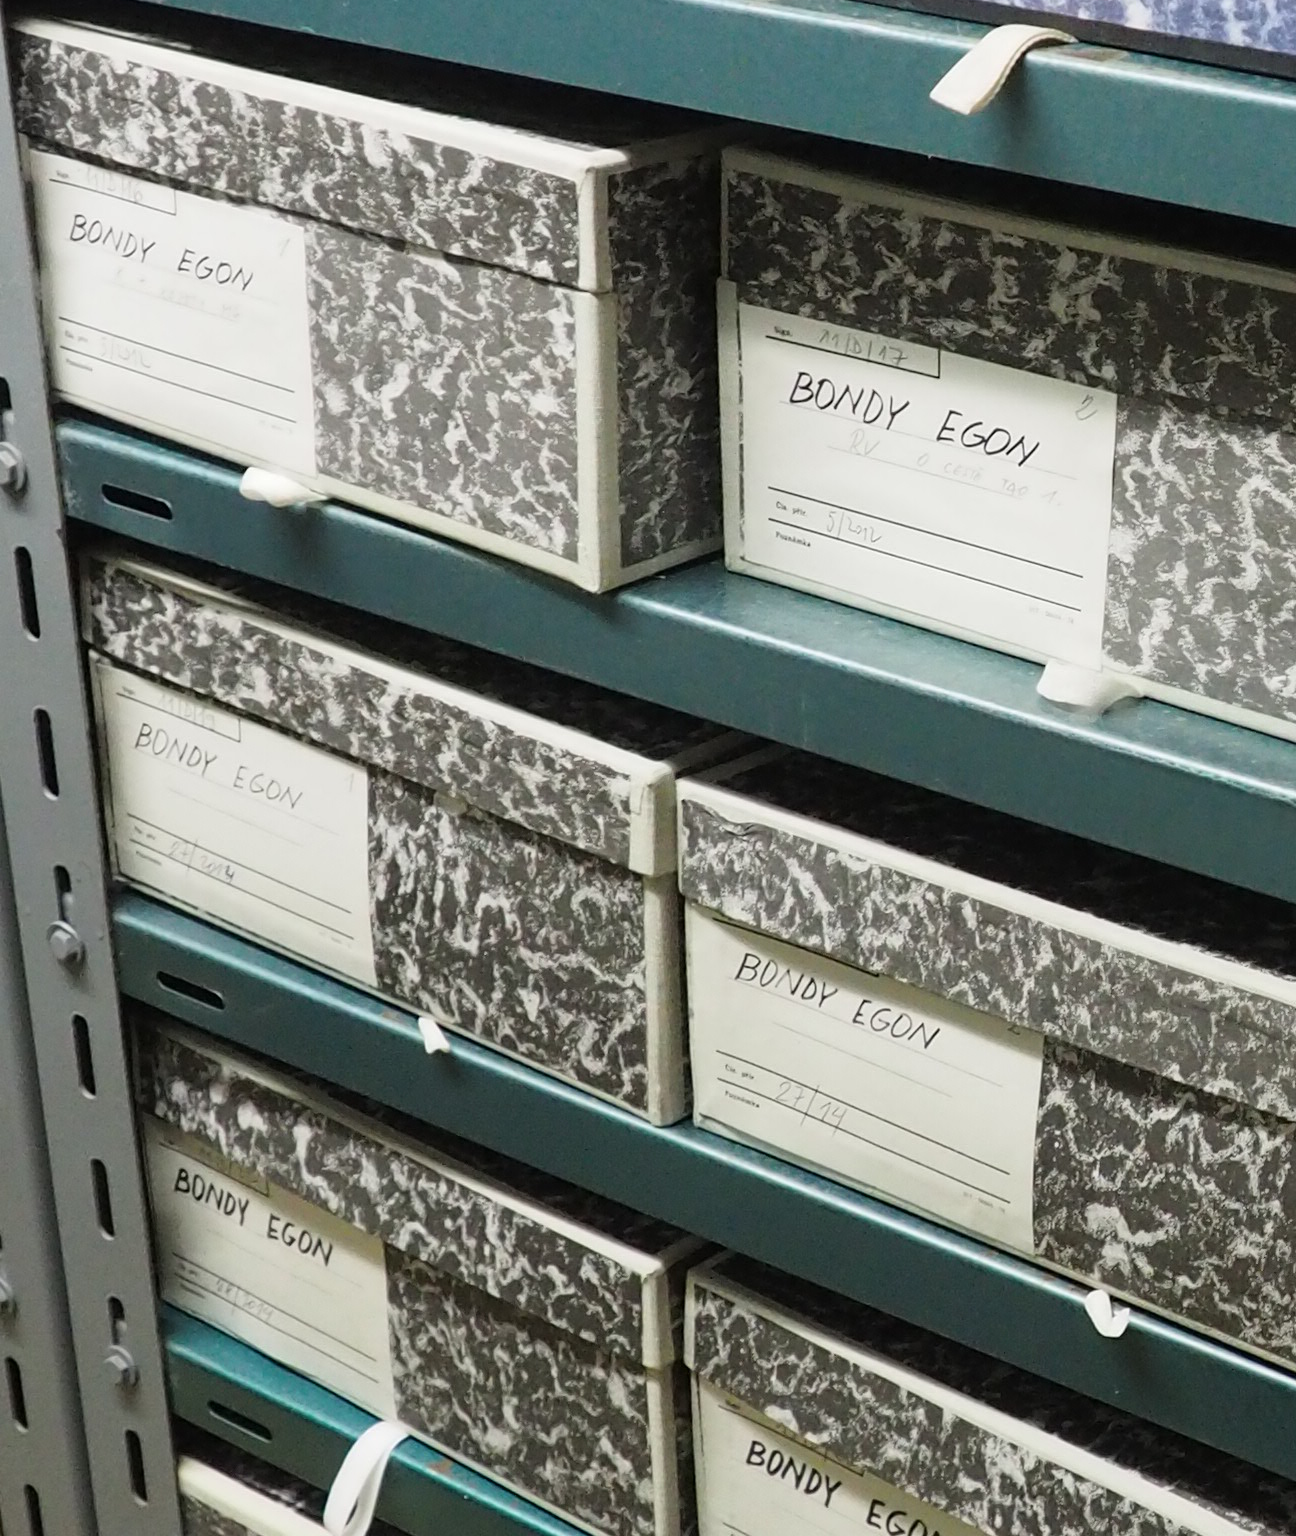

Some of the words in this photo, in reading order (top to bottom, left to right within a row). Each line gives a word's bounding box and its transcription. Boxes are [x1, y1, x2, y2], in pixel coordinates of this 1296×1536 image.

[70, 214, 156, 263] BONDY
[178, 249, 253, 291] EGON
[789, 371, 910, 430] BONDY
[936, 410, 1040, 466] EGON
[135, 723, 218, 777] BONDY
[233, 765, 303, 809] EGON
[735, 953, 839, 1008] BONDY
[852, 1000, 941, 1049] EGON
[174, 1167, 250, 1227] BONDY
[266, 1212, 333, 1267] EGON
[746, 1439, 842, 1508] BONDY
